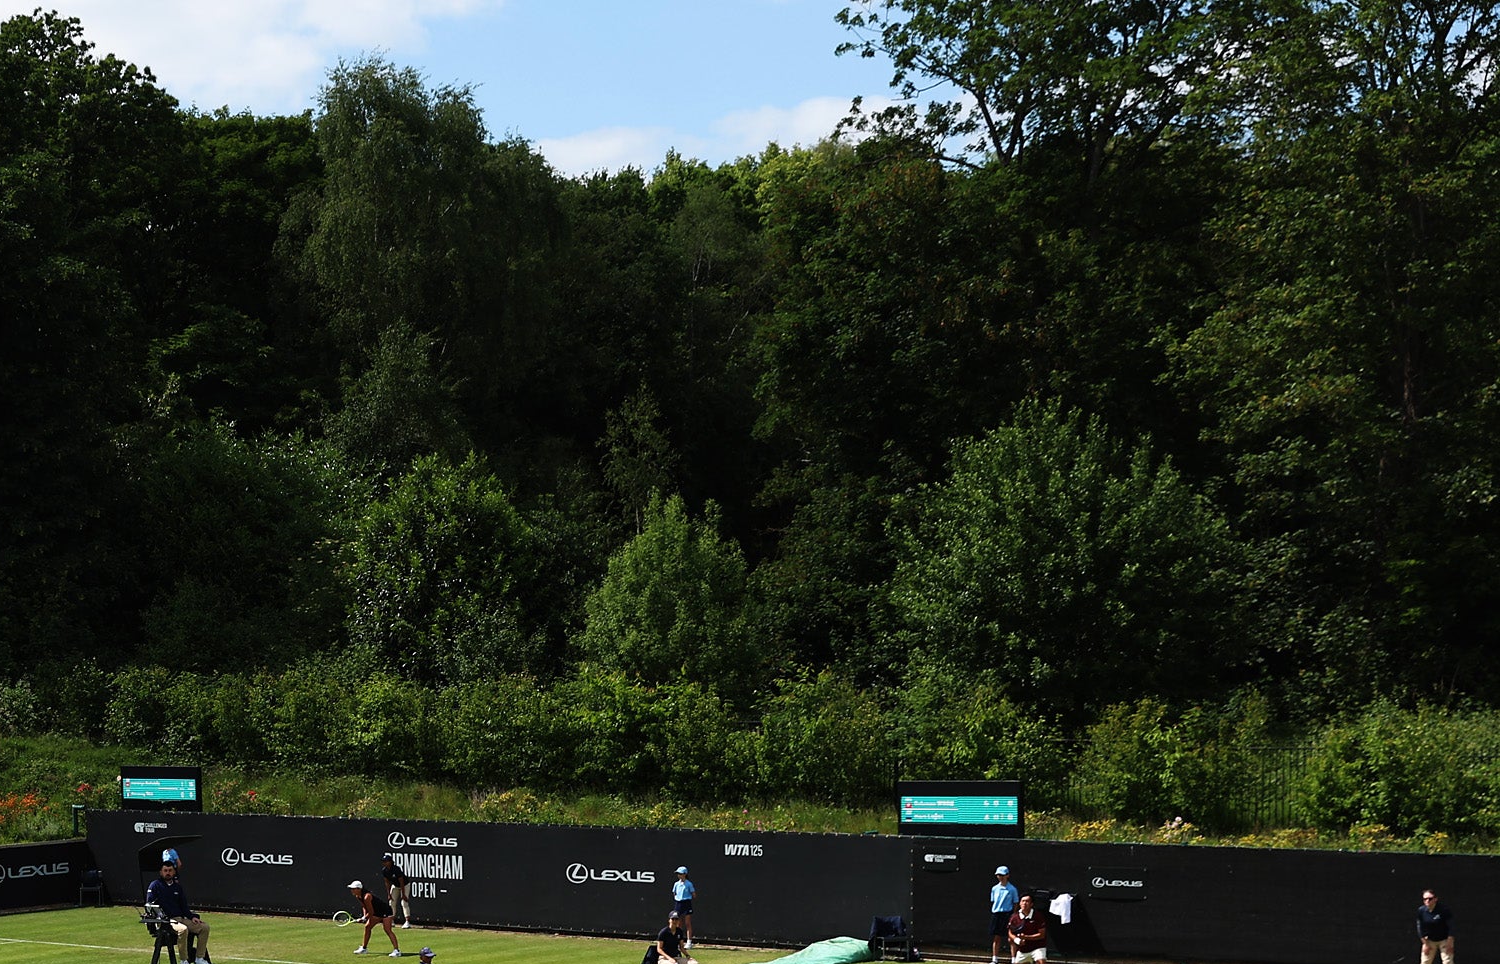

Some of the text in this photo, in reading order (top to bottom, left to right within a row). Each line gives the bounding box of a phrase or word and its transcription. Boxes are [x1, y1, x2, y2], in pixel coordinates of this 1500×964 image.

[405, 836, 458, 848] LEXUS
[240, 852, 294, 865] LEXUS
[7, 862, 69, 879] LEXUS
[589, 868, 655, 883] LEXUS
[411, 881, 436, 899] OPEN
[1105, 879, 1143, 887] LEXUS
